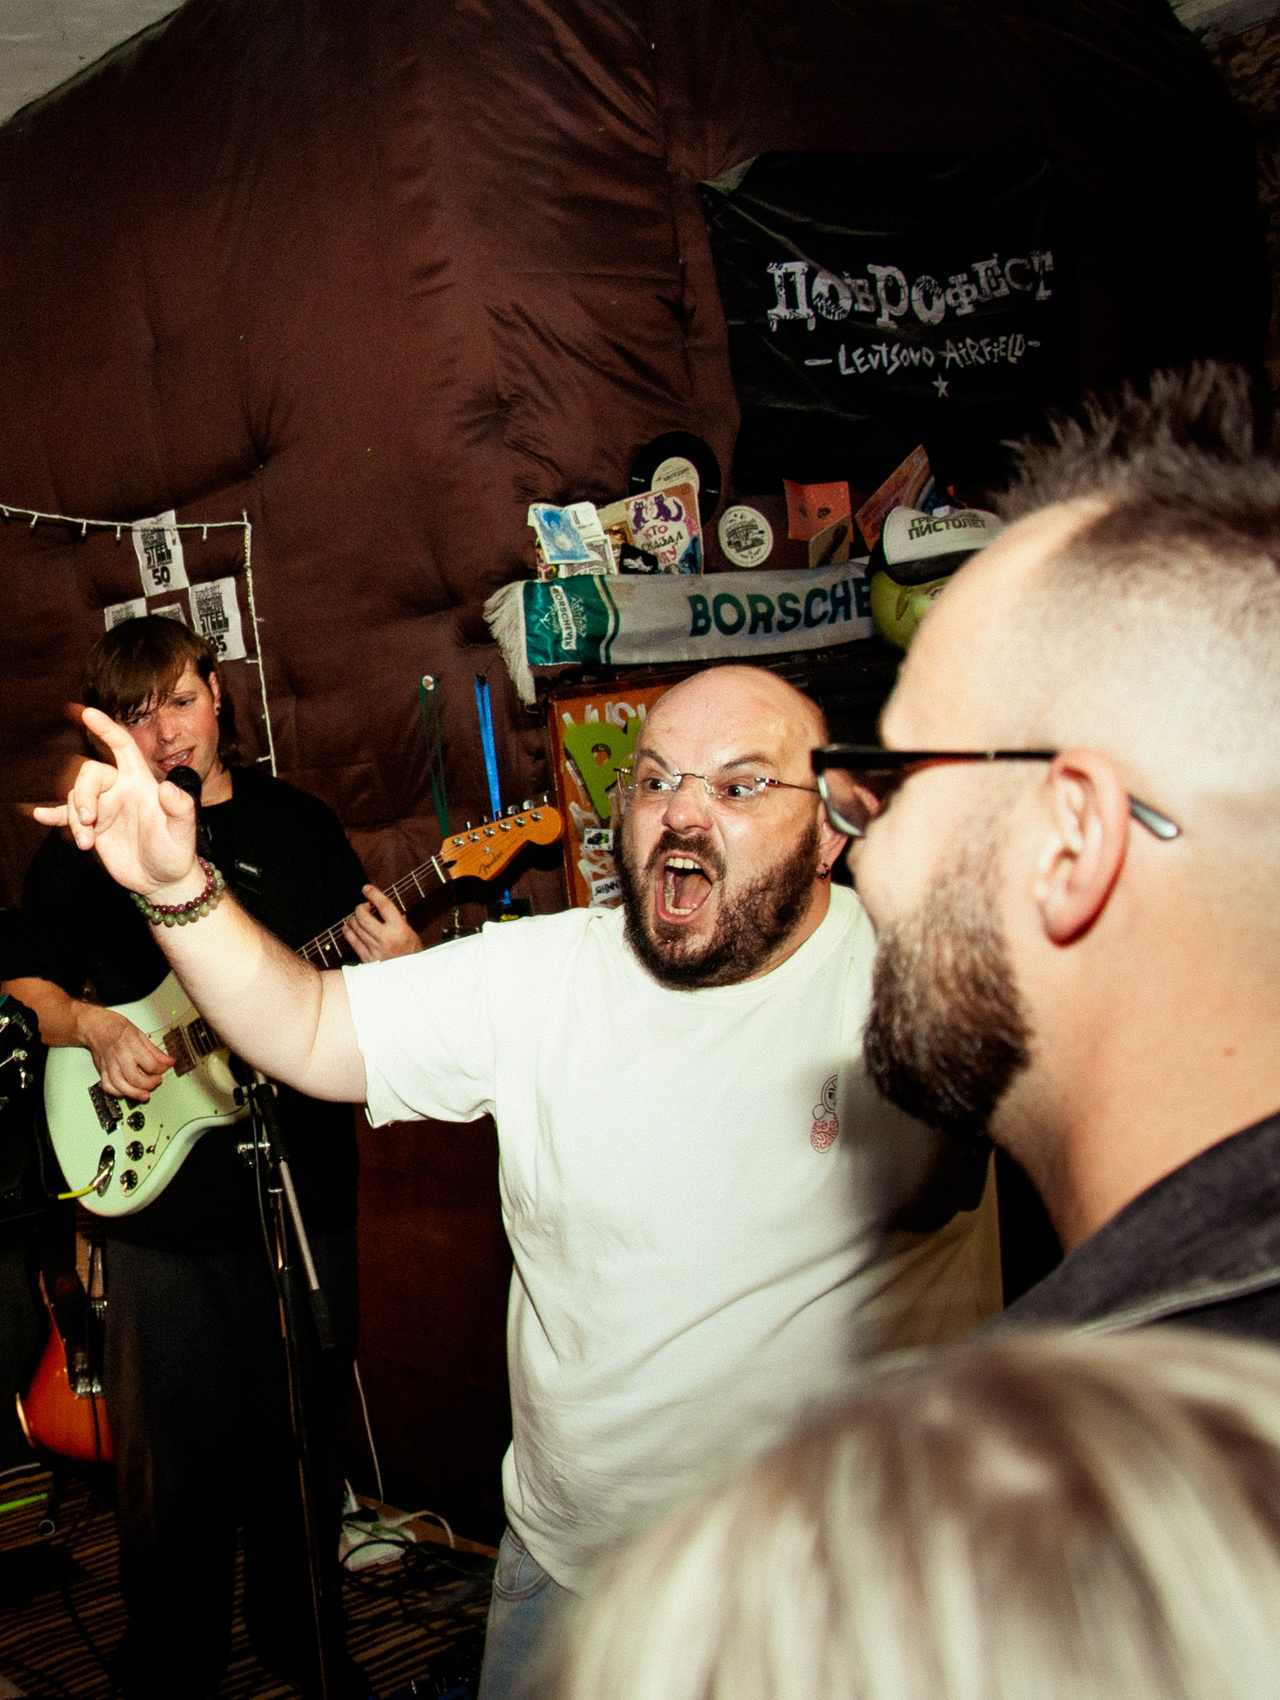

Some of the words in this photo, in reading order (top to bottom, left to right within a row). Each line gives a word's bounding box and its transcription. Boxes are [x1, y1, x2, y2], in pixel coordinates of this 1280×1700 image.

[838, 343, 935, 376] LEVTSOVO
[643, 524, 669, 541] КТО
[907, 517, 987, 540] ПИСТОЛЕТ
[641, 530, 684, 551] СКАЗАЛ
[152, 565, 171, 586] 50
